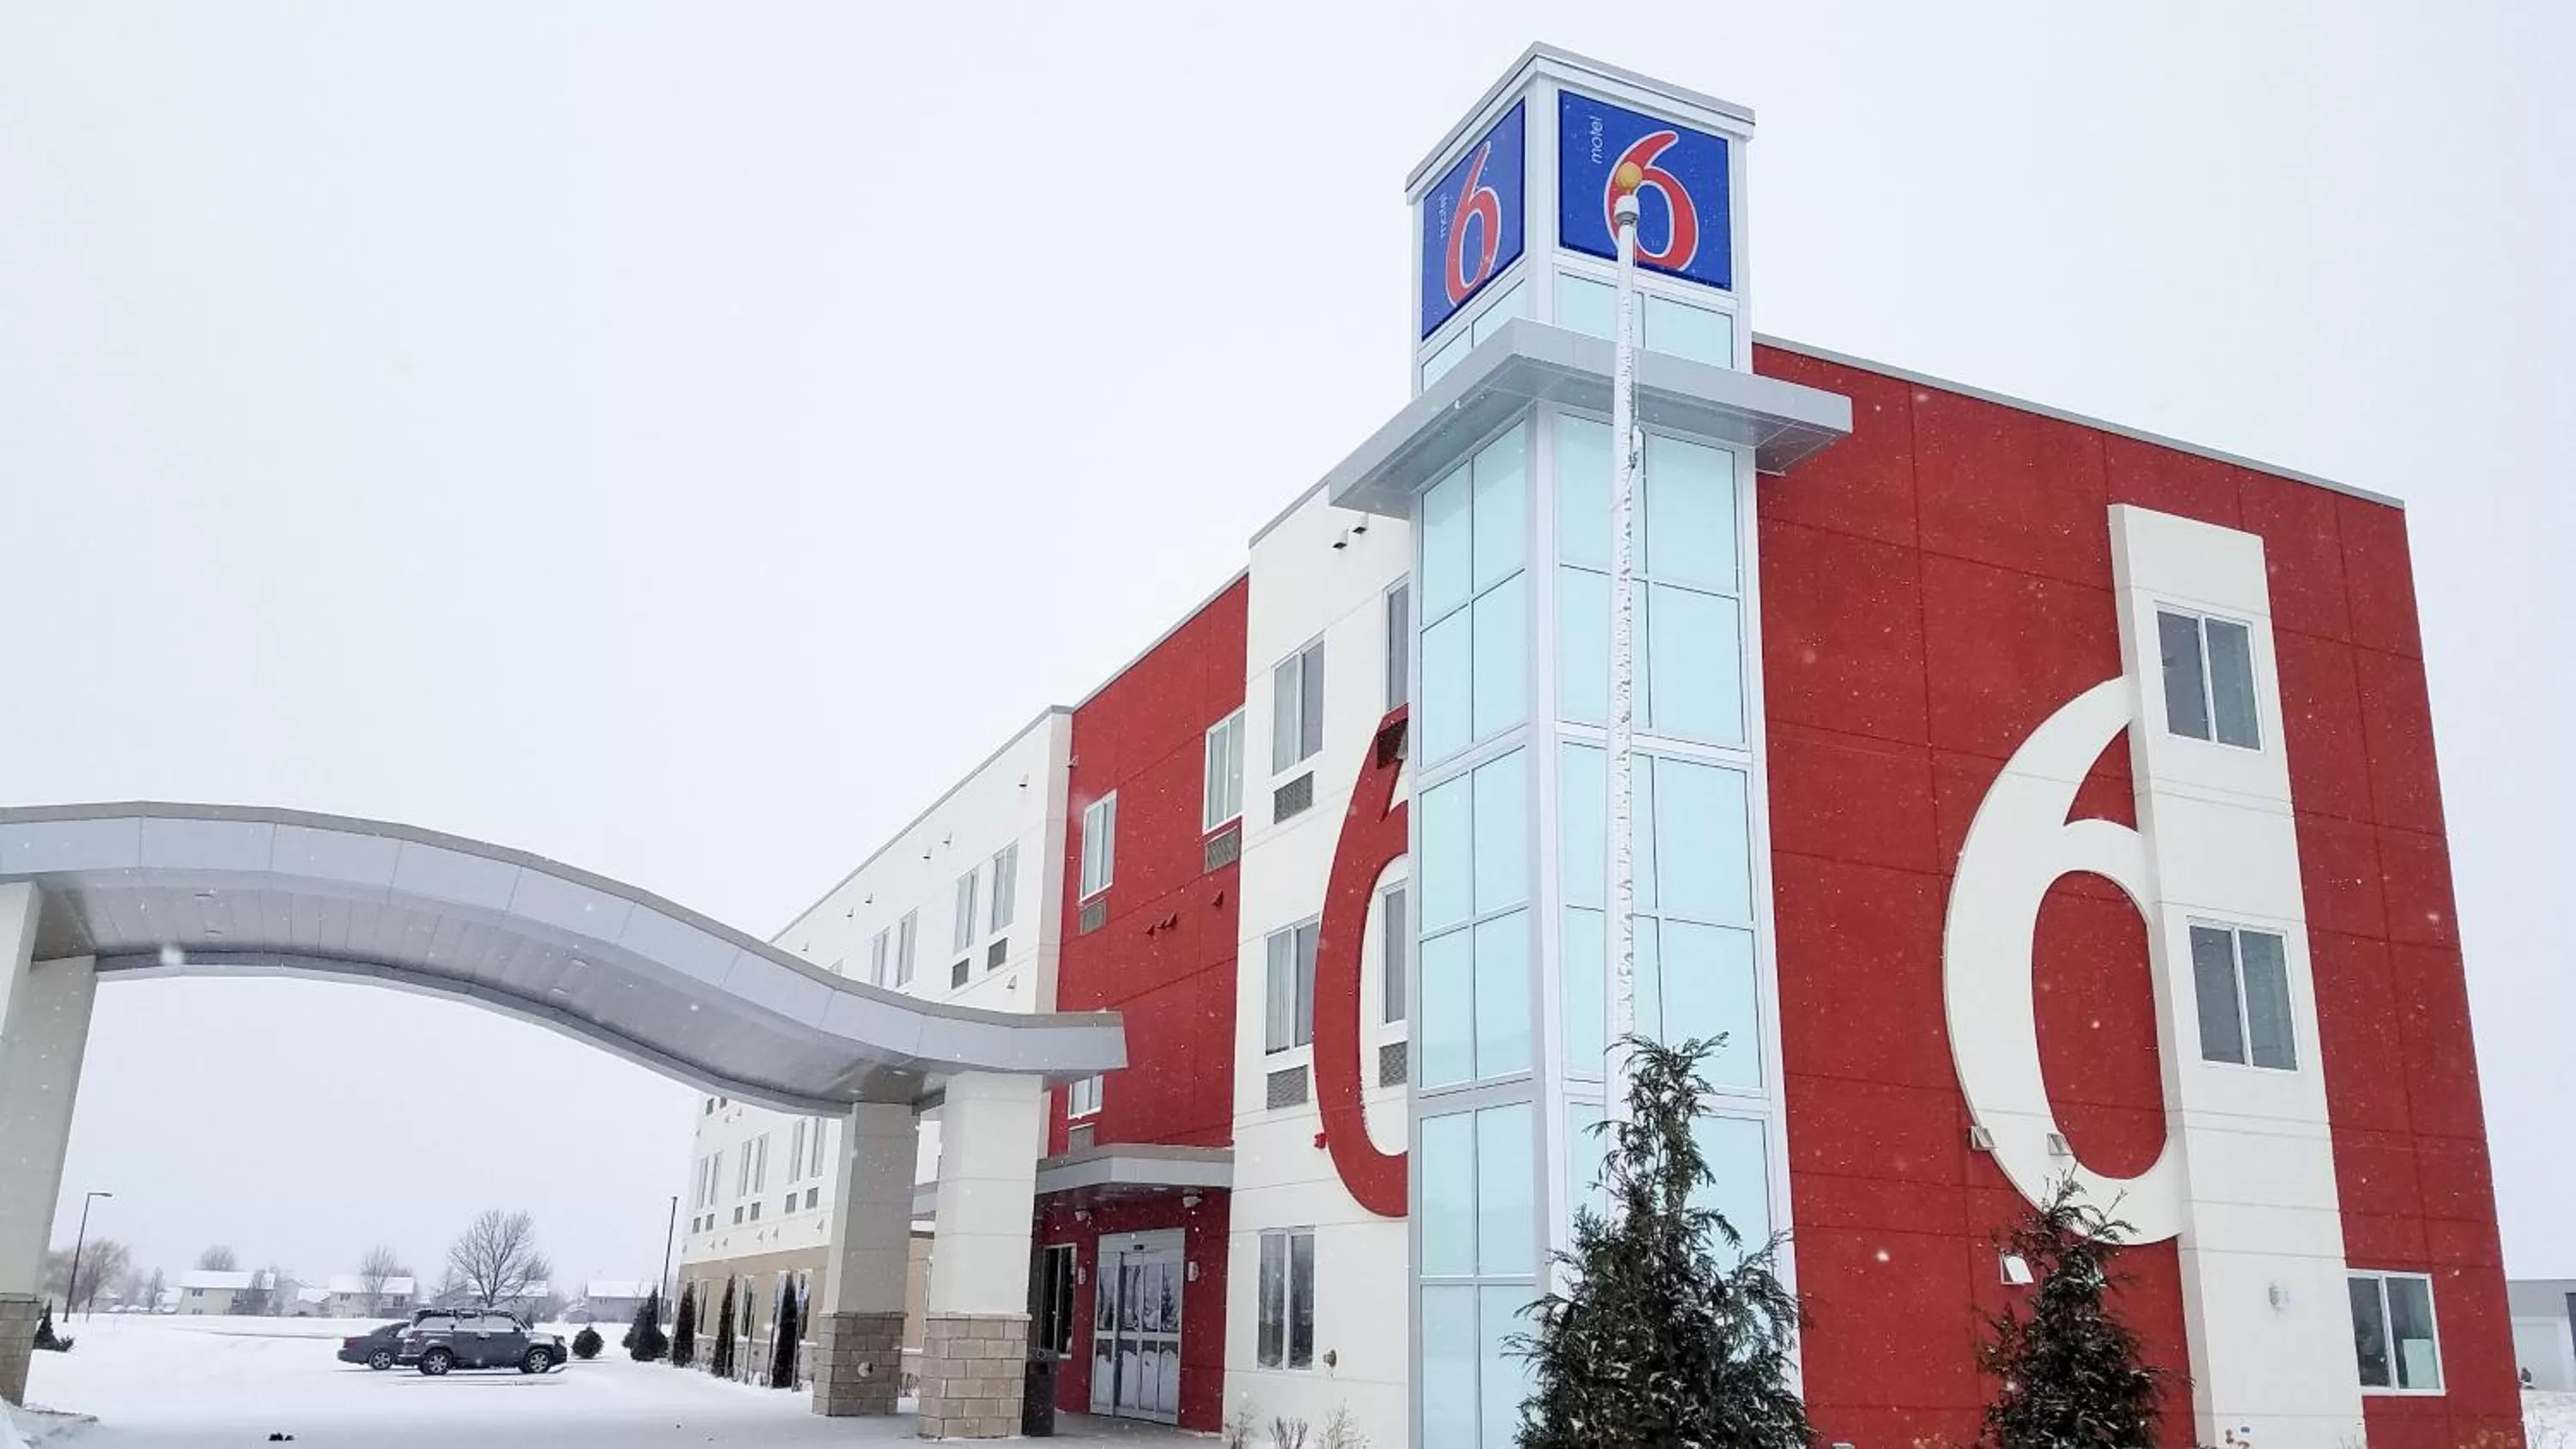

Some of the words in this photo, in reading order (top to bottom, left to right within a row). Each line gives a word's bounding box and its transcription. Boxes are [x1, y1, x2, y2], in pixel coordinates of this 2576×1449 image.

[1589, 115, 1603, 164] motel
[1604, 130, 1699, 271] 6
[1445, 140, 1502, 308] 6
